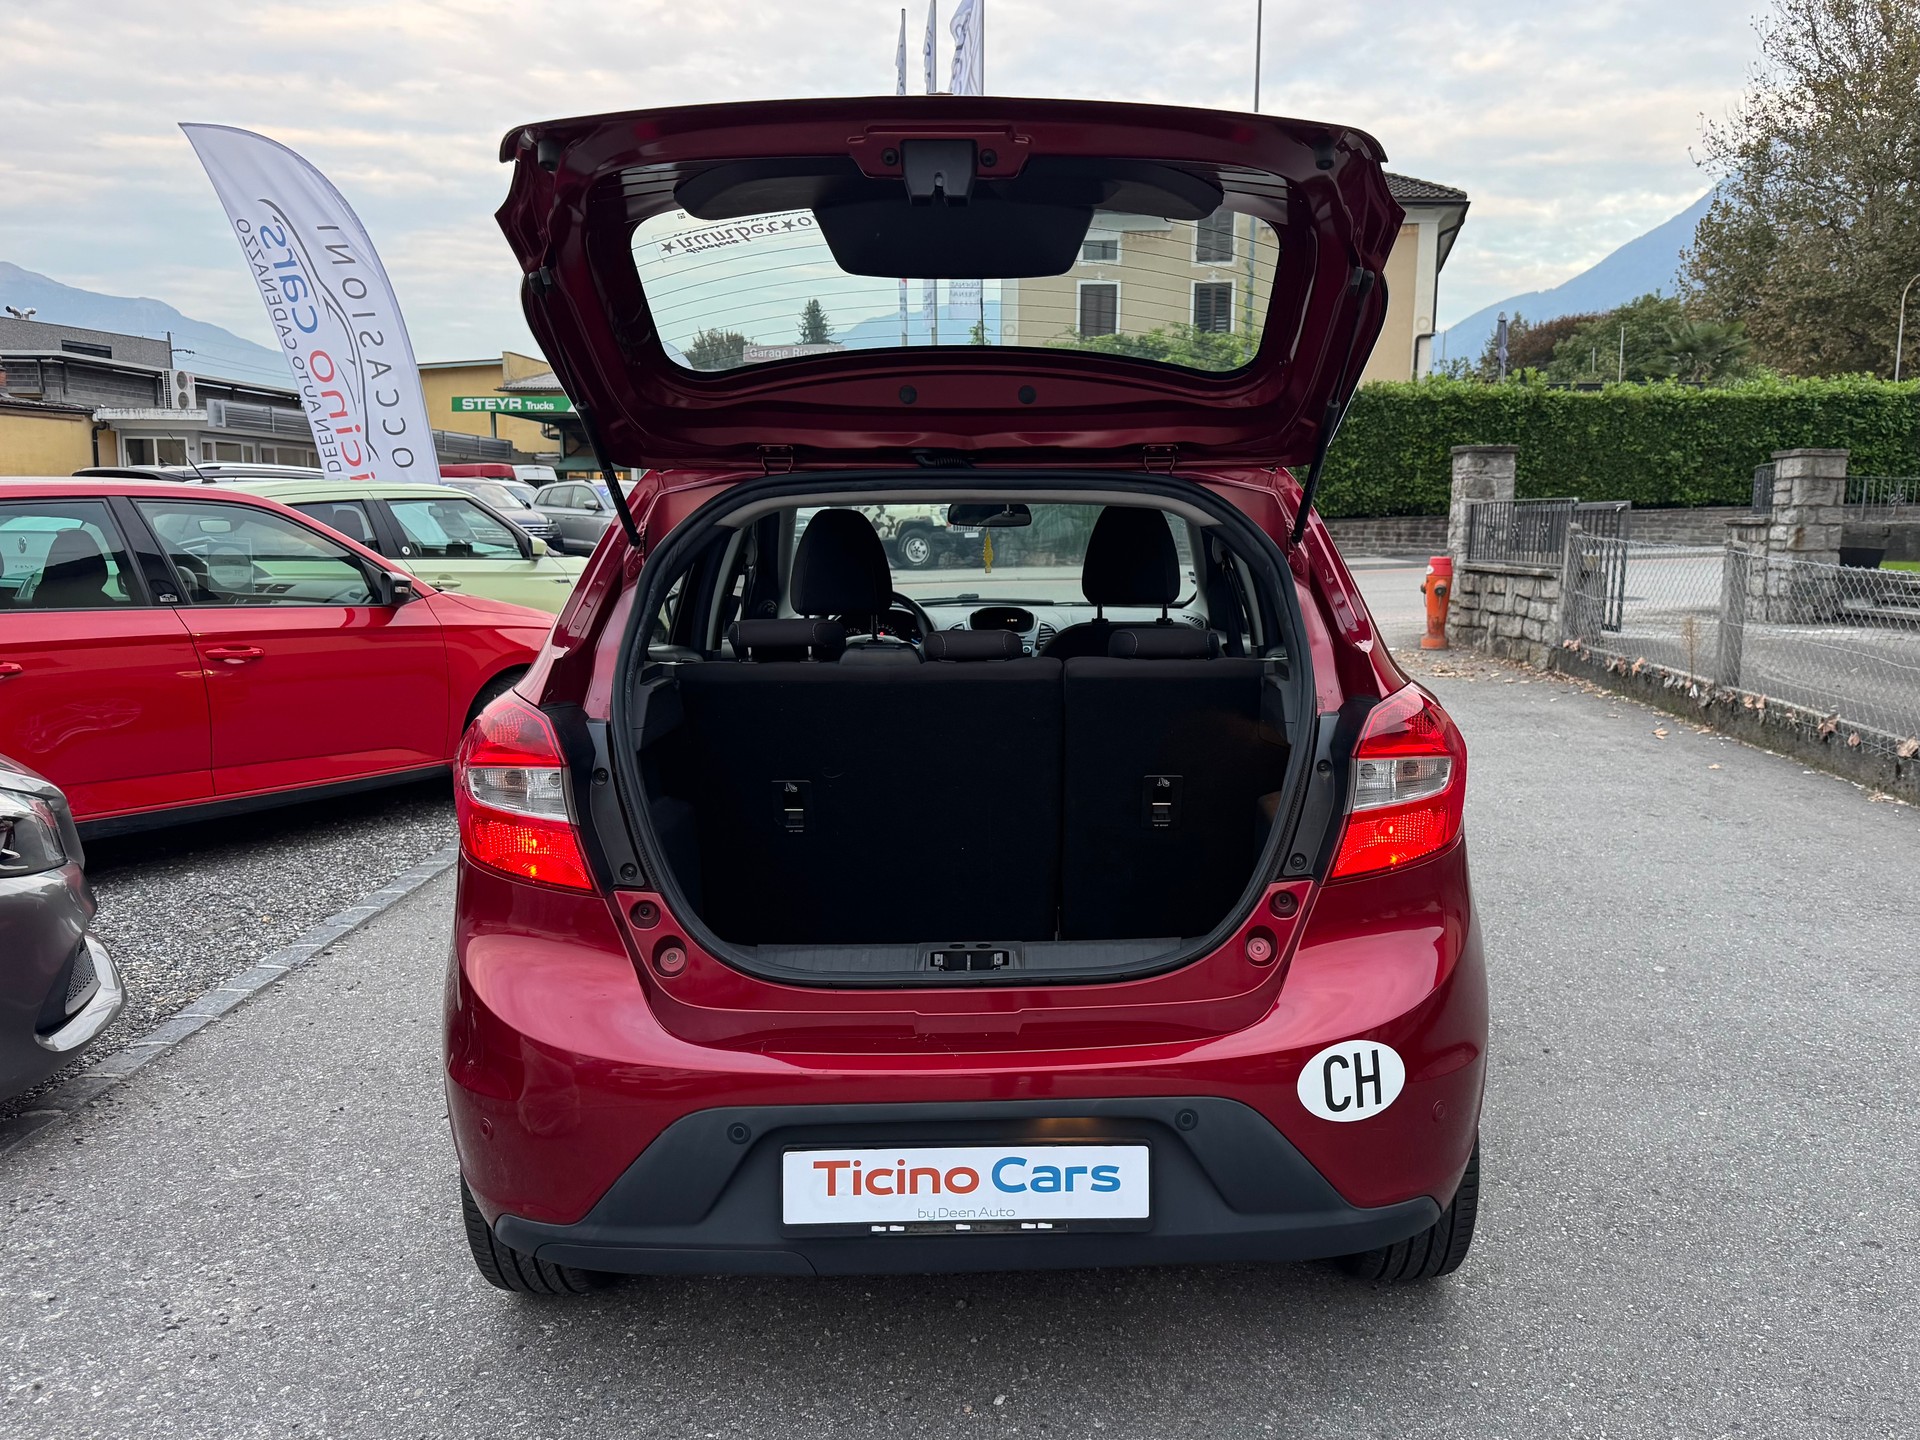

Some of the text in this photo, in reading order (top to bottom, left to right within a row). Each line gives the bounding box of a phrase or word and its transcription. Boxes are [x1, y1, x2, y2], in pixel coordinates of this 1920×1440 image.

[749, 348, 788, 358] Garage
[462, 398, 554, 410] STEYR Trucks
[1323, 1049, 1382, 1112] CH
[813, 1156, 1120, 1197] Ticino Cars
[917, 1206, 1016, 1221] by Deen Auto
